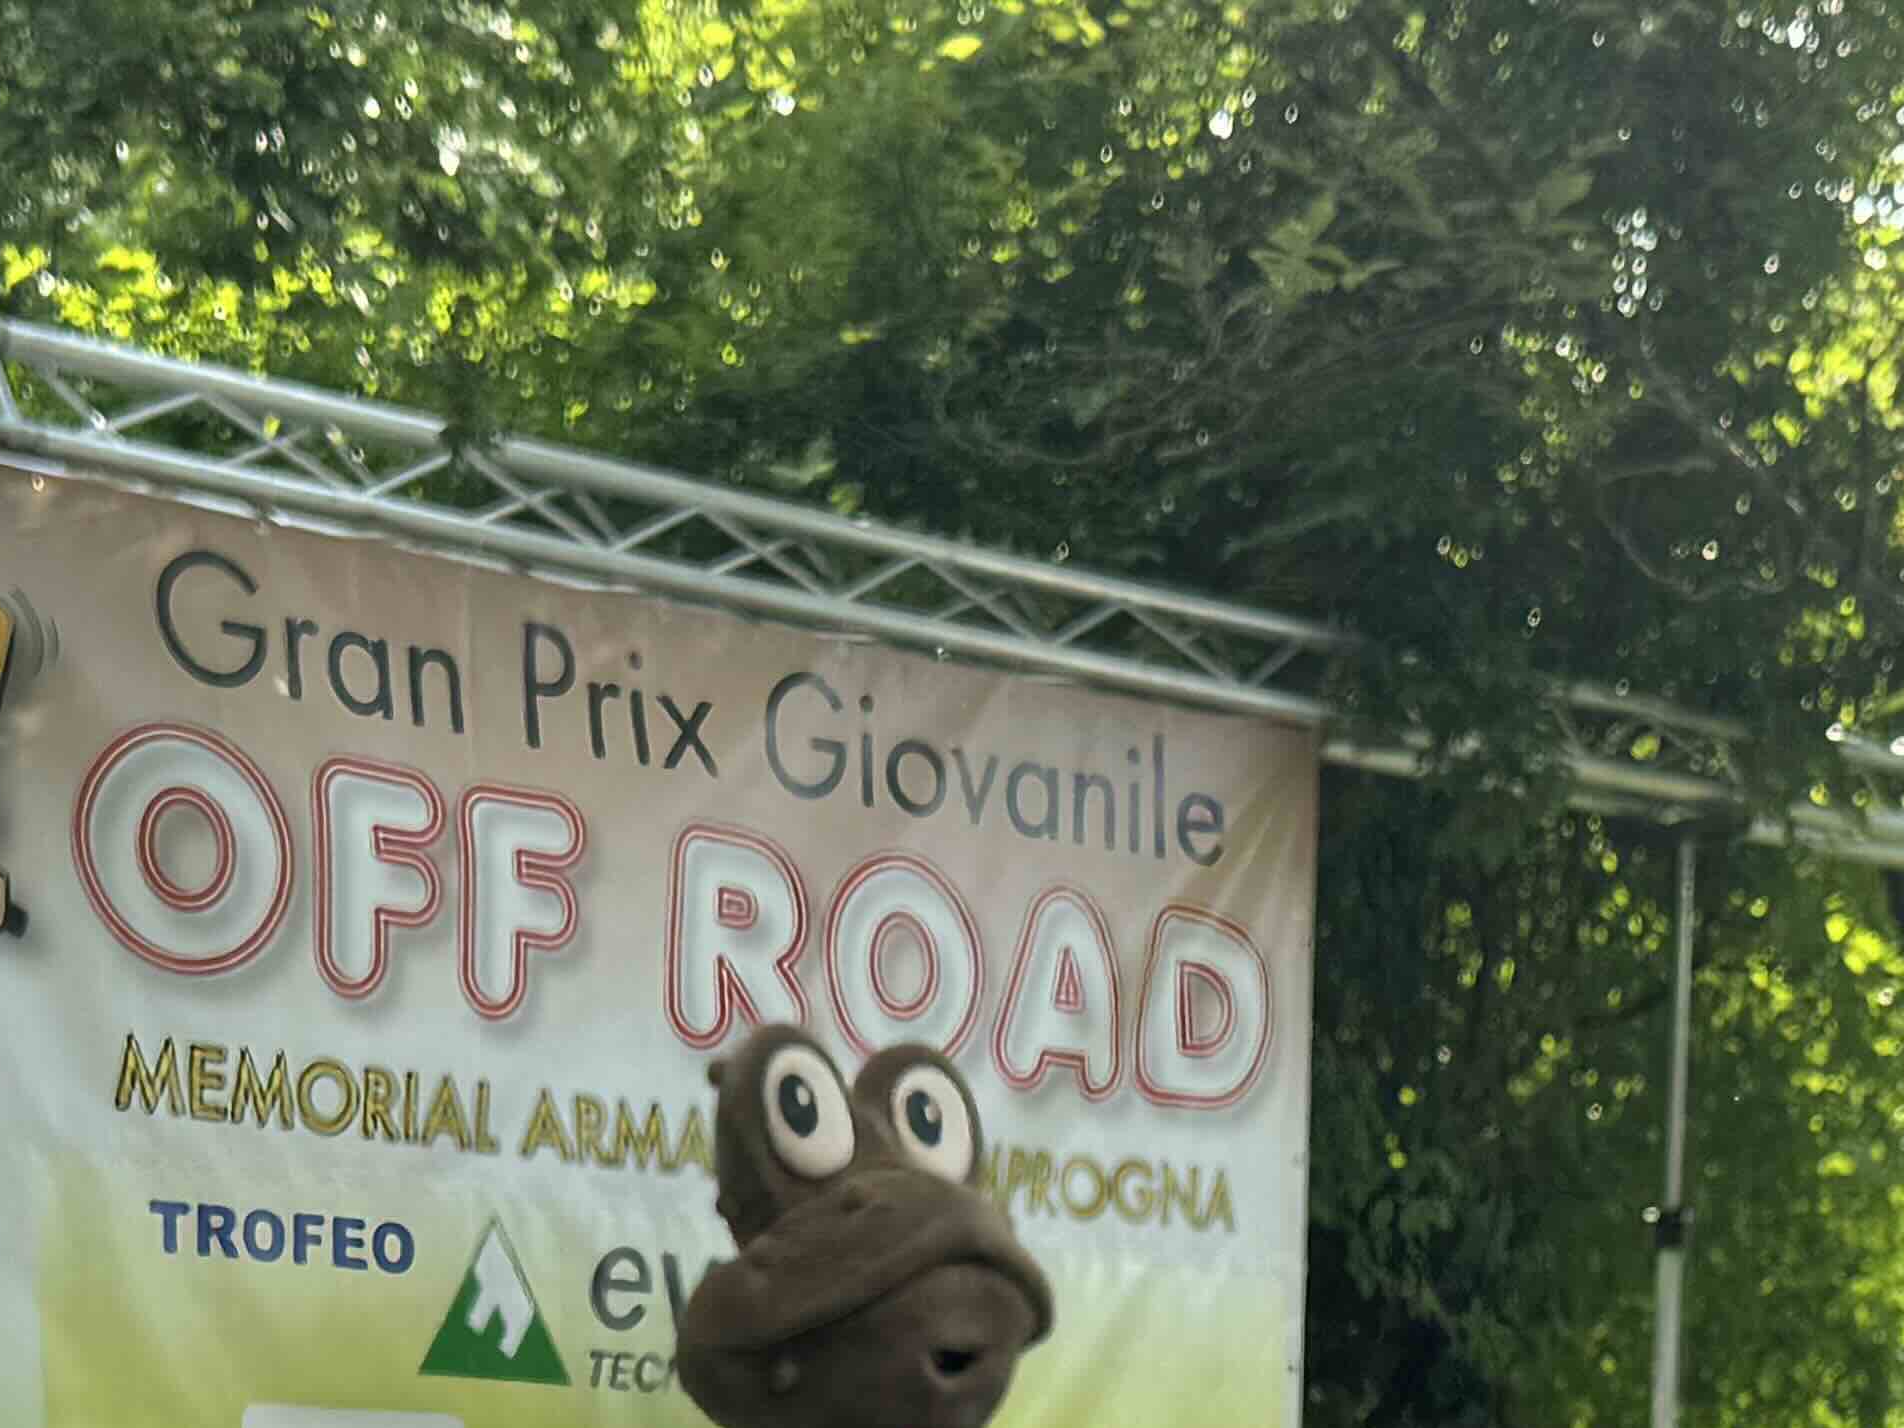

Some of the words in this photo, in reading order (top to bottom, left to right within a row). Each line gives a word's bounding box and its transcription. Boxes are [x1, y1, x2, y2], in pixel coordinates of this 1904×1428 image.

[154, 548, 464, 736] Gran
[522, 620, 718, 780] Prix
[763, 671, 1226, 869] Giovanile
[73, 720, 587, 1021] OFF
[663, 822, 1272, 1110] ROAD
[112, 1030, 497, 1156] MEMORIAL
[519, 1088, 718, 1180] ARMA
[148, 1198, 416, 1274] TROFEO
